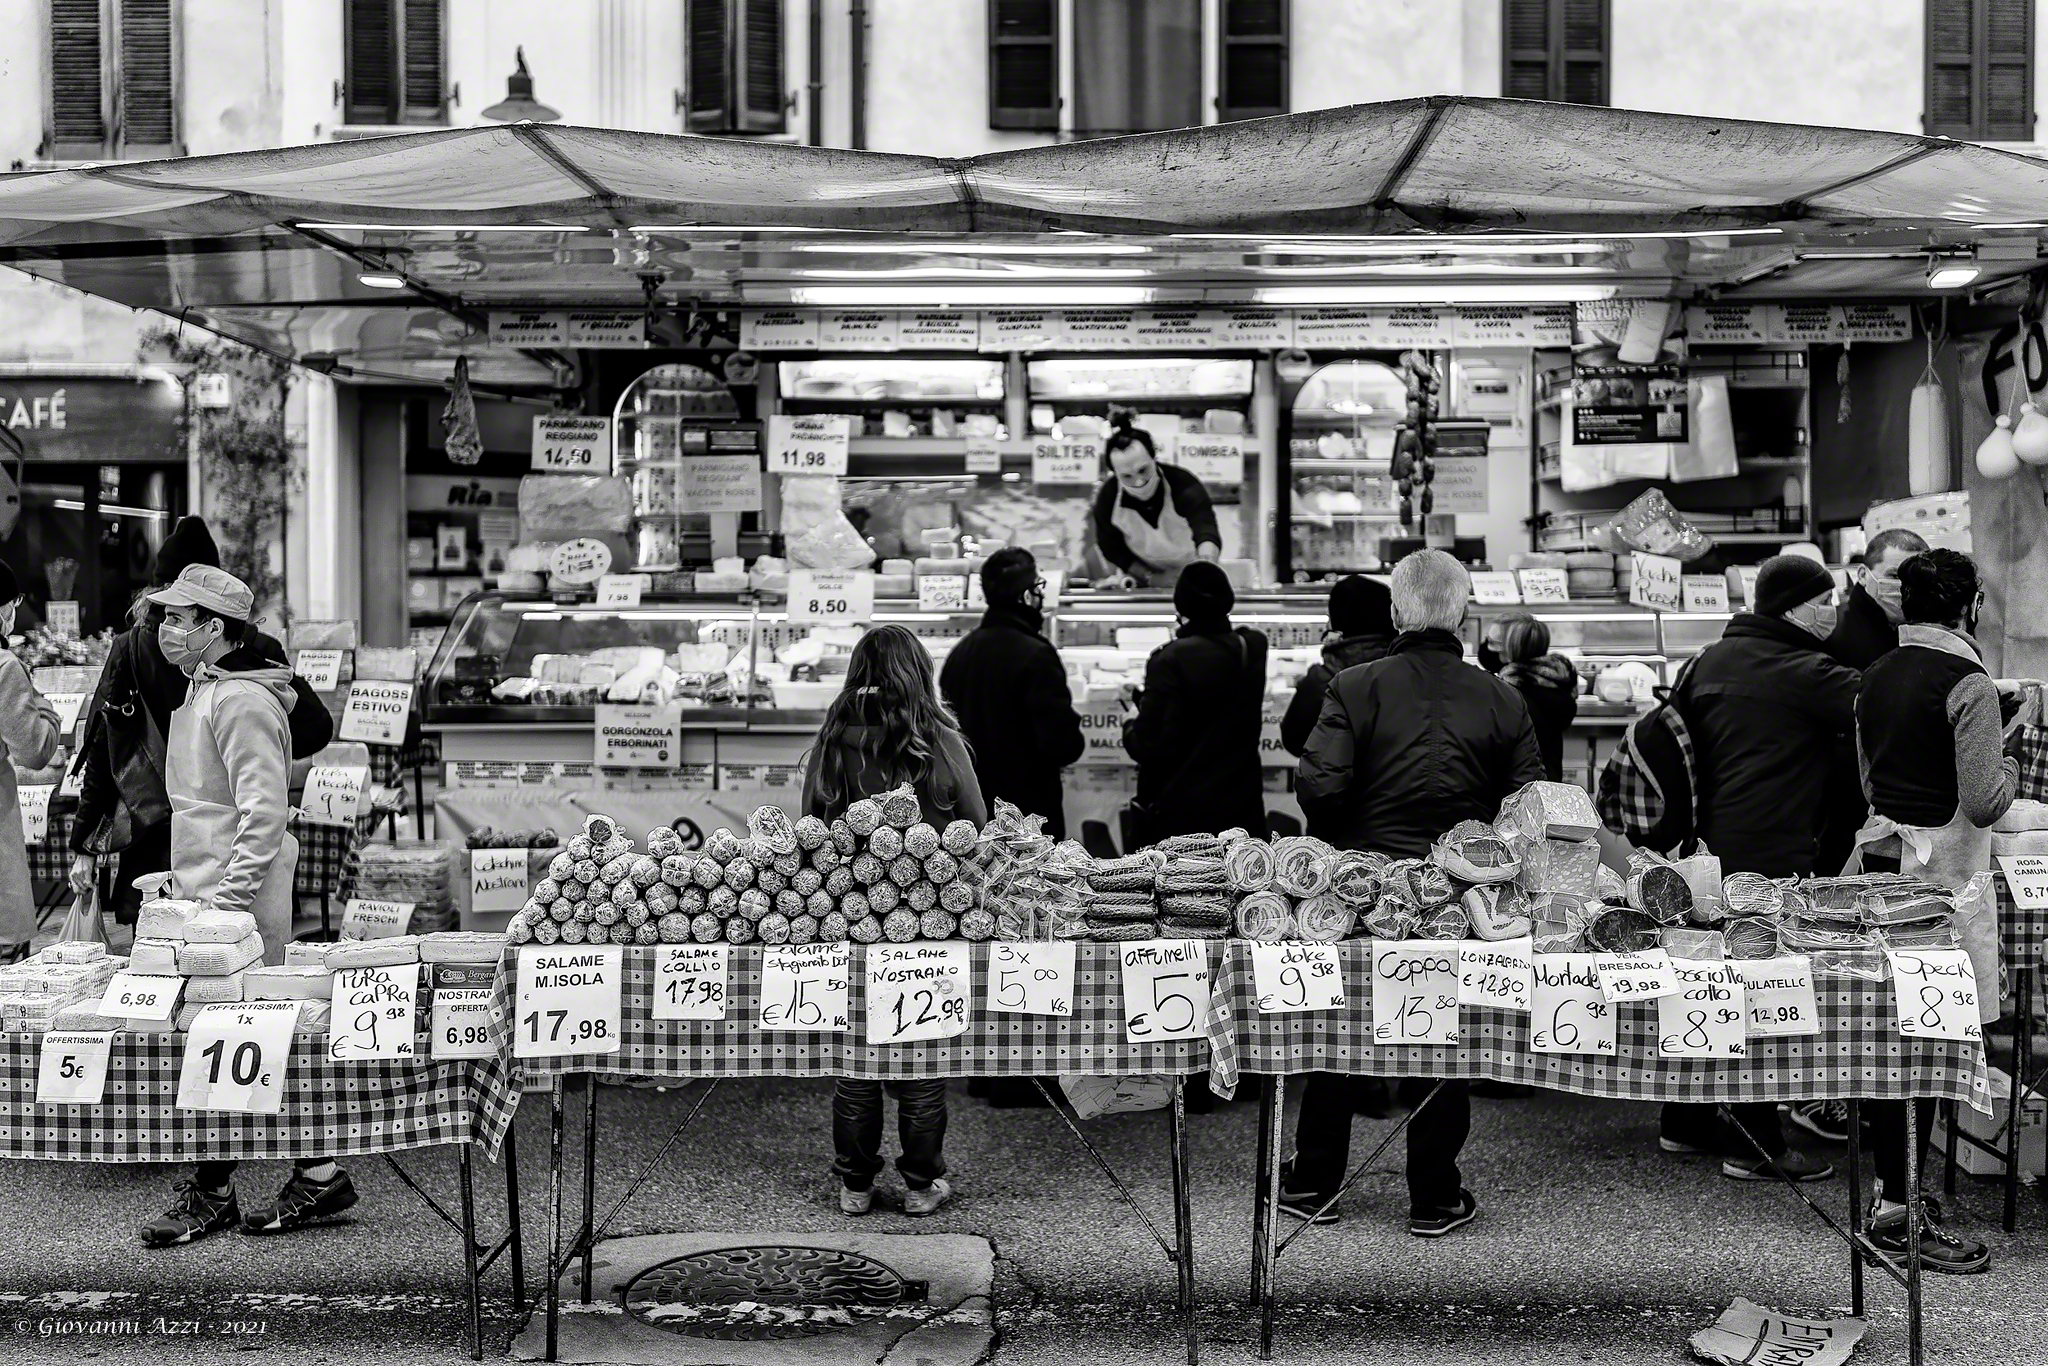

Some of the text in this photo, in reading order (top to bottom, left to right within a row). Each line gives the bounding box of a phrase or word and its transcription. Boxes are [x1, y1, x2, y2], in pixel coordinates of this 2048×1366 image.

[0, 388, 66, 430] AFÉ
[539, 420, 606, 431] PARMIGIANO
[546, 431, 599, 442] REGGIANO
[782, 448, 826, 467] 11,98
[1036, 444, 1097, 460] SILTER
[1178, 443, 1240, 458] TOMBEA
[809, 598, 847, 615] 8,50
[1694, 595, 1718, 607] 6,98
[352, 700, 403, 713] ESTIVO
[602, 725, 674, 738] GORGONZOLA
[607, 738, 668, 749] ERBORINATI
[2016, 859, 2044, 868] ROSA
[2014, 868, 2048, 877] CAMUN
[358, 902, 400, 914] RAVIOLI
[353, 913, 399, 925] FRESCHI
[535, 954, 605, 970] SALAME
[671, 948, 720, 961] SALAME
[873, 965, 959, 984] NOSTRANO
[1377, 951, 1458, 989] Coppa
[535, 972, 606, 989] M.ISOLA
[1478, 973, 1526, 999] 12,80
[1612, 977, 1662, 995] 19,98
[119, 991, 157, 1008] 6,98
[665, 977, 724, 1008] 17,98
[206, 1001, 295, 1012] OFFERTISSIMA
[451, 1003, 489, 1013] OFFERTA
[237, 1013, 255, 1025] 1x
[1750, 1005, 1802, 1026] 12,98
[523, 1009, 609, 1045] 17,98
[46, 1035, 105, 1045] OFFERTISSIMA
[446, 1026, 489, 1047] 6,98
